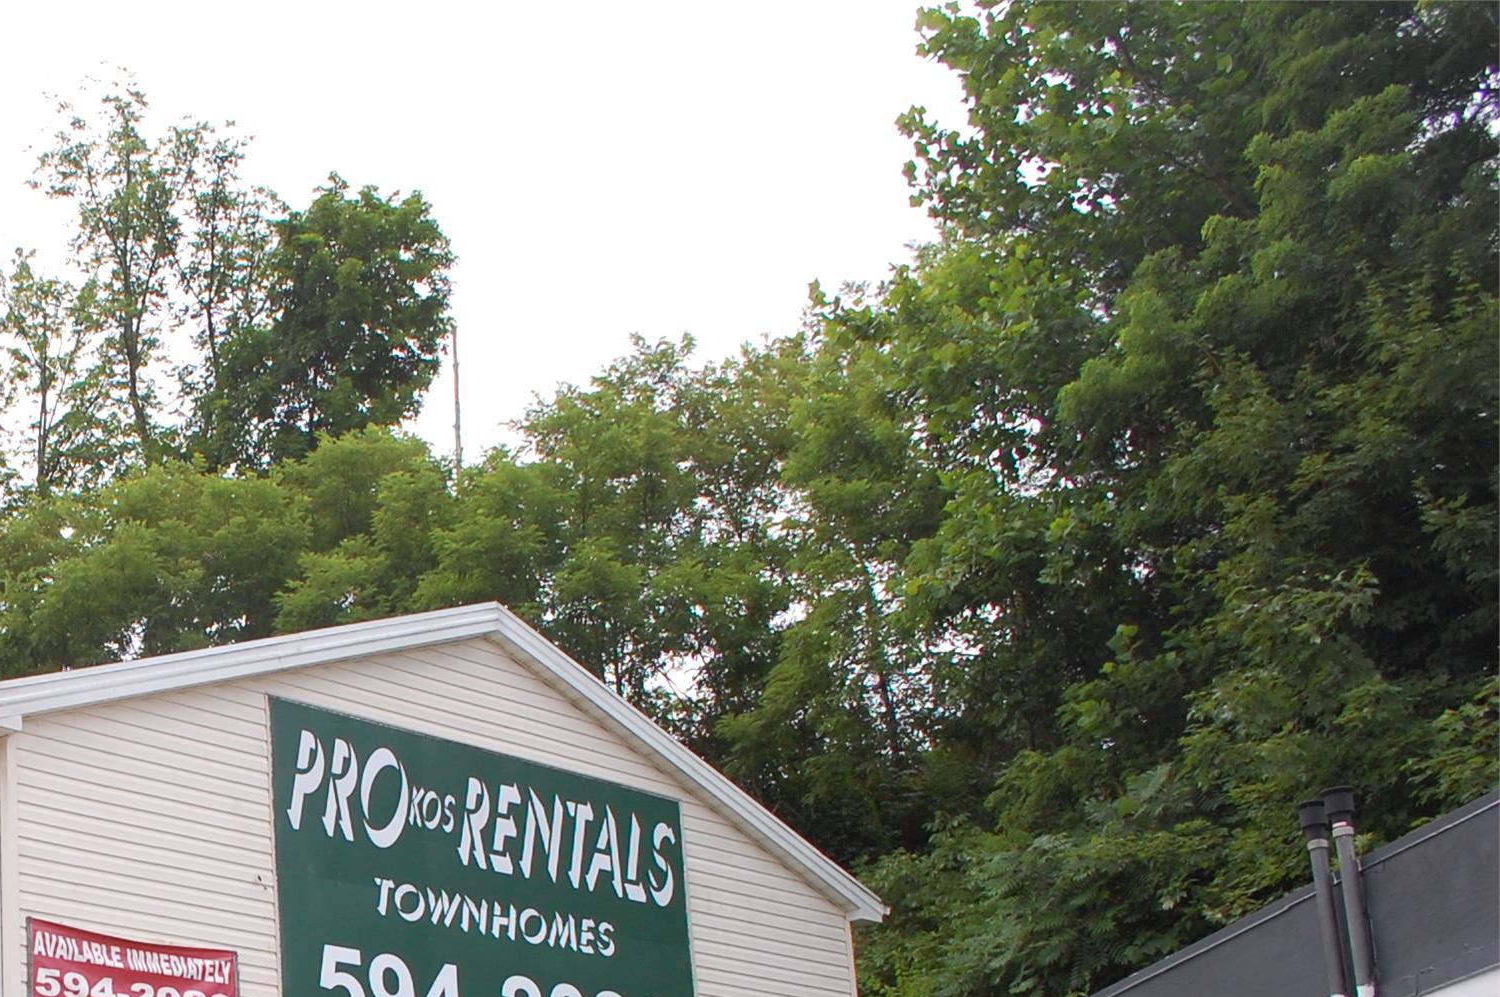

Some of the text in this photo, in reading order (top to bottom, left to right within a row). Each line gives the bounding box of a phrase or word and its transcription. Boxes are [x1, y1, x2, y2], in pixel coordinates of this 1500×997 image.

[457, 776, 676, 907] RENTALS
[374, 877, 615, 957] TOWNHOMES
[34, 931, 231, 985] AVAILABLE IMMEDIATELY
